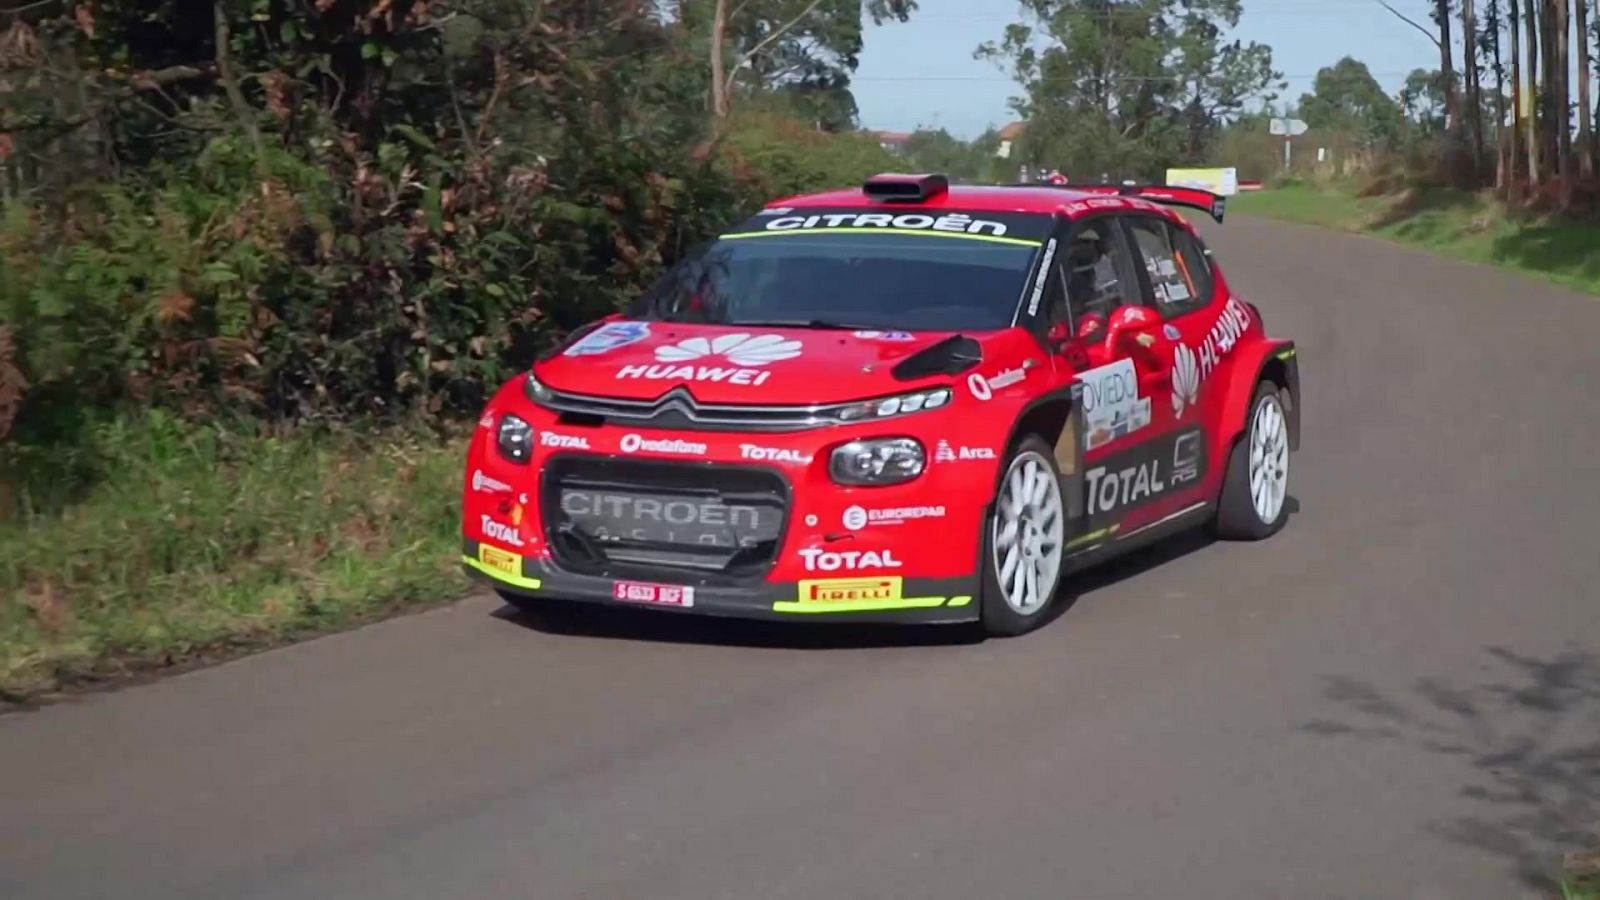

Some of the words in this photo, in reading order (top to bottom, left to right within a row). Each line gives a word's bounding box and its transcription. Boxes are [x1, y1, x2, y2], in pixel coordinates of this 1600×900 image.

[615, 365, 771, 387] HUAWEI
[1083, 368, 1136, 413] OVIEDO
[539, 431, 591, 450] TOTAL
[640, 438, 707, 455] vodafone
[739, 444, 814, 464] TOTAL
[1085, 459, 1164, 515] TOTAL
[481, 514, 525, 547] TOTAL
[798, 549, 903, 571] TOTAL
[810, 581, 891, 601] PIRELLI
